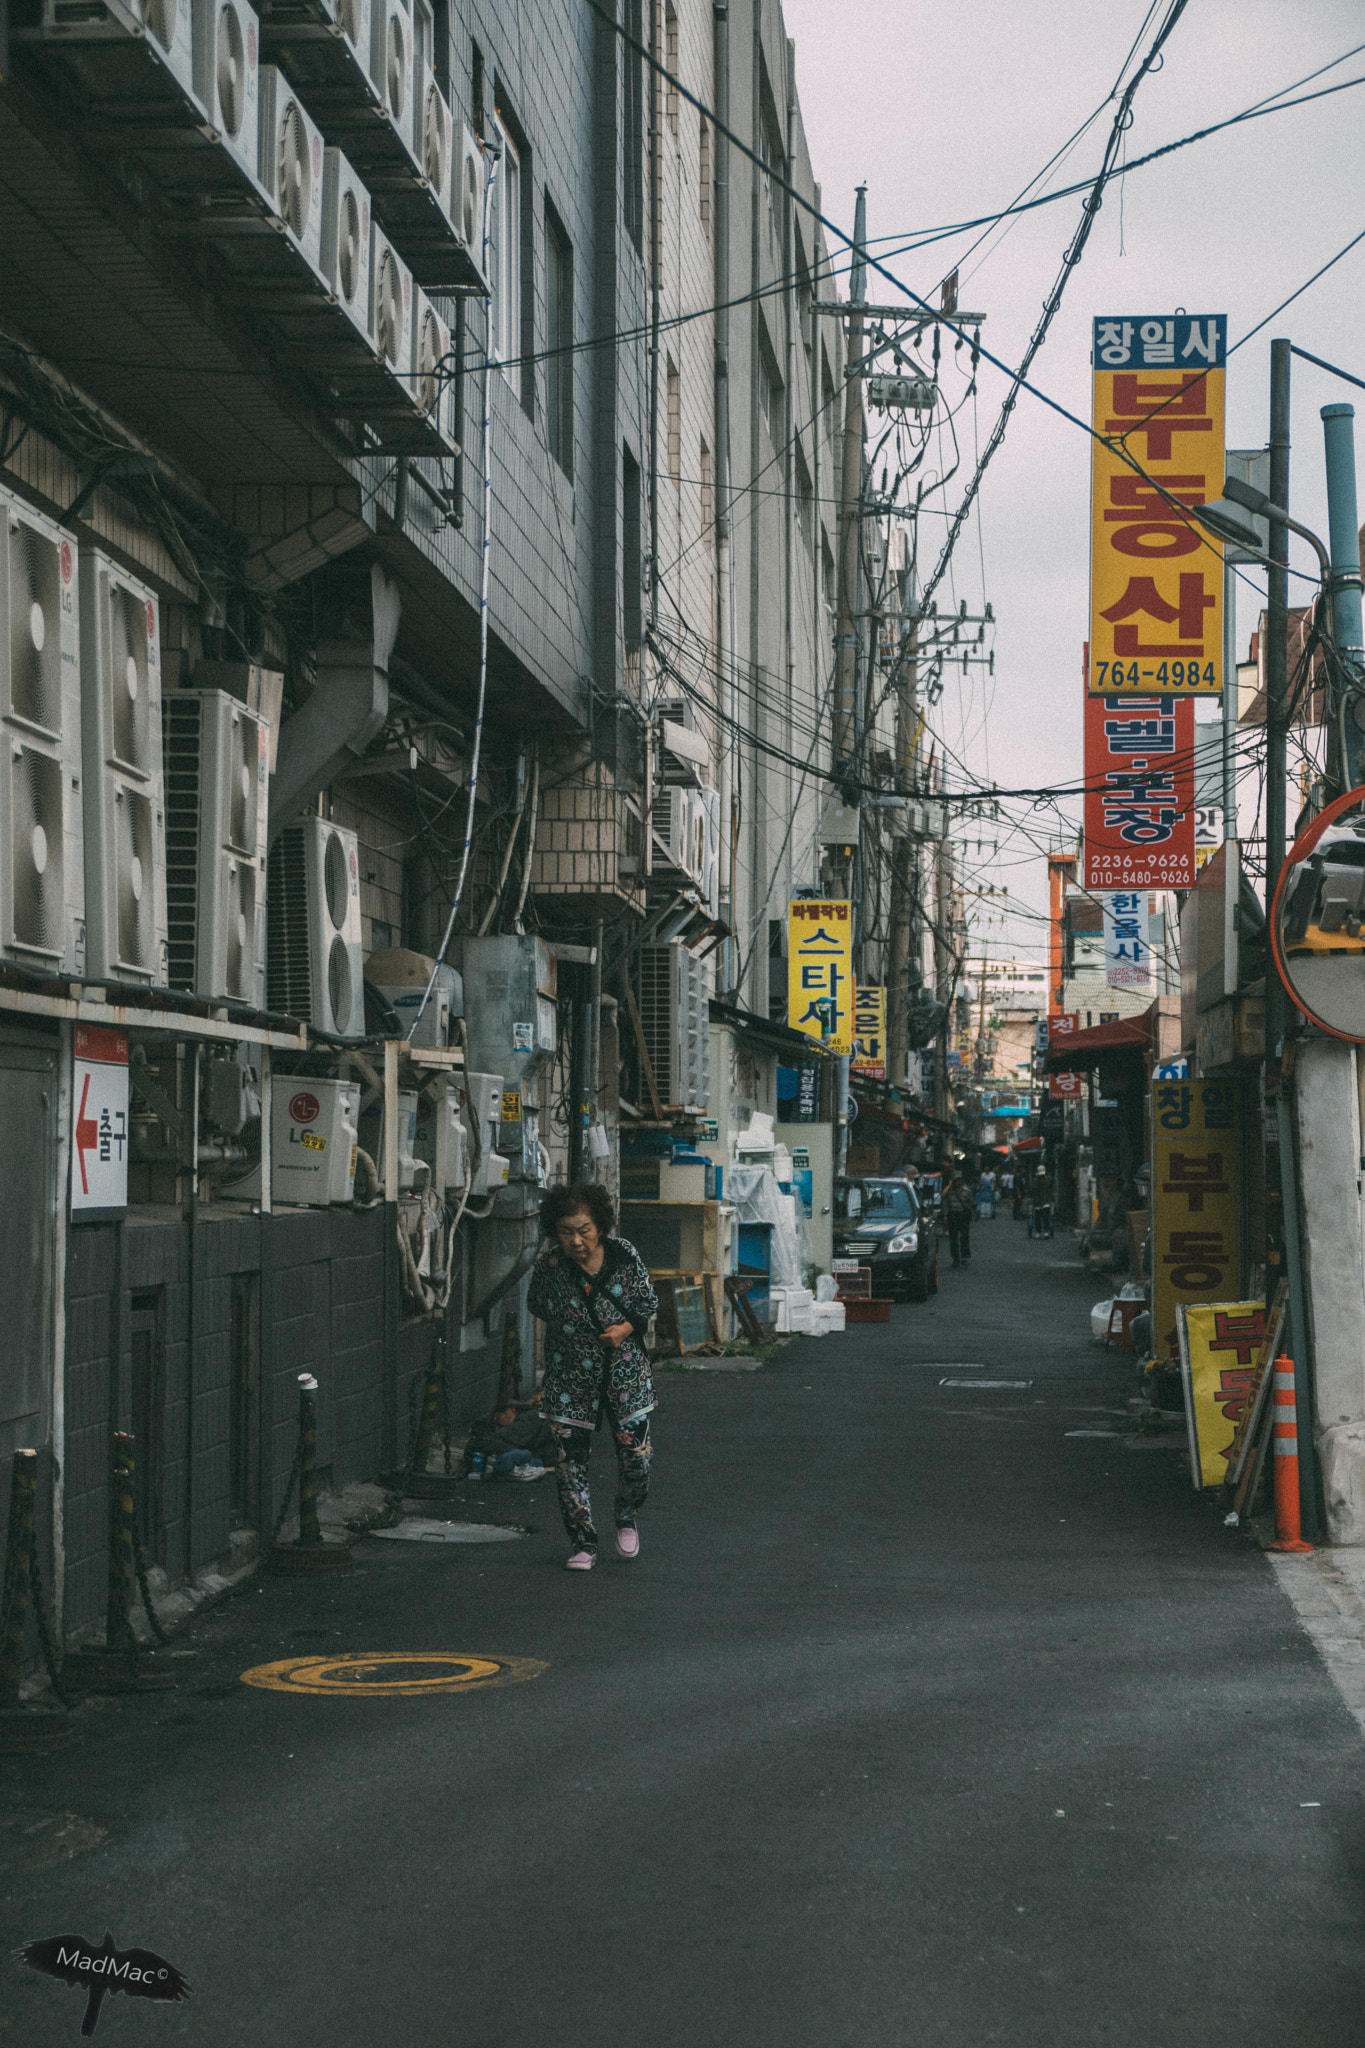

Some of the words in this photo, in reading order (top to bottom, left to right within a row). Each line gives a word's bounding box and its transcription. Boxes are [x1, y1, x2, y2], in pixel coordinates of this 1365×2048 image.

[1096, 319, 1221, 365] 창일사
[1098, 373, 1217, 658] 부동산
[62, 588, 72, 614] LG
[1096, 660, 1216, 687] 764-4984
[1091, 854, 1190, 869] 2236-9626
[1091, 871, 1190, 885] 010-5480-9626
[797, 927, 846, 1035] 스타사
[855, 989, 881, 1060] 조은사
[1157, 1086, 1235, 1130] 창일
[98, 1108, 127, 1162] 출구
[1209, 1310, 1267, 1461] 부동
